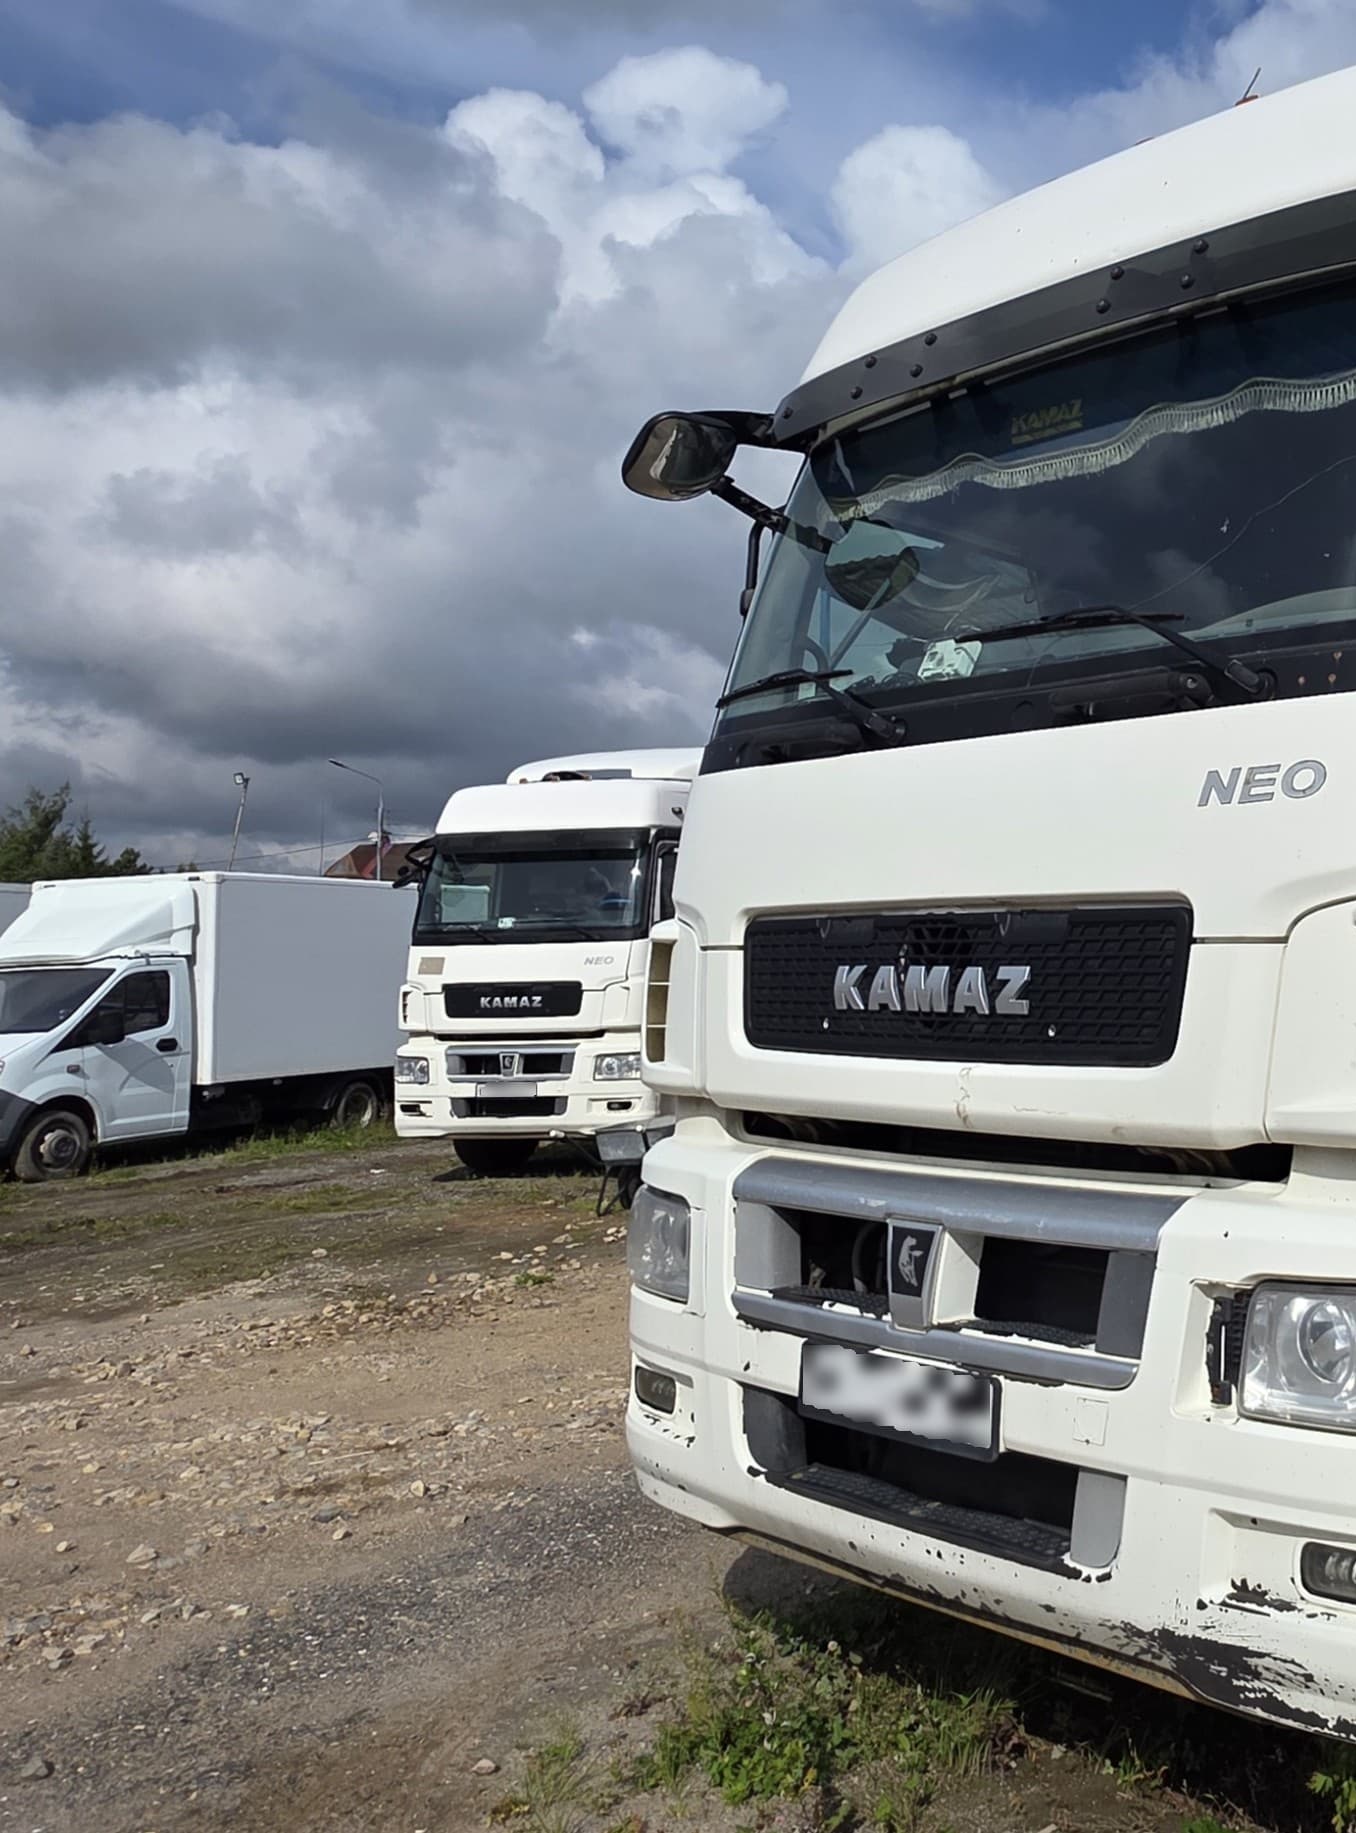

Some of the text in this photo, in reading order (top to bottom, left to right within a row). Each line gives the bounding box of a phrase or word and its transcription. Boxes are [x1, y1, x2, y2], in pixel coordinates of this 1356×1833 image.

[1197, 759, 1327, 807] NEO
[583, 956, 614, 966] NEO
[480, 996, 543, 1009] KAMAZ
[832, 964, 1032, 1016] KAMAZ
